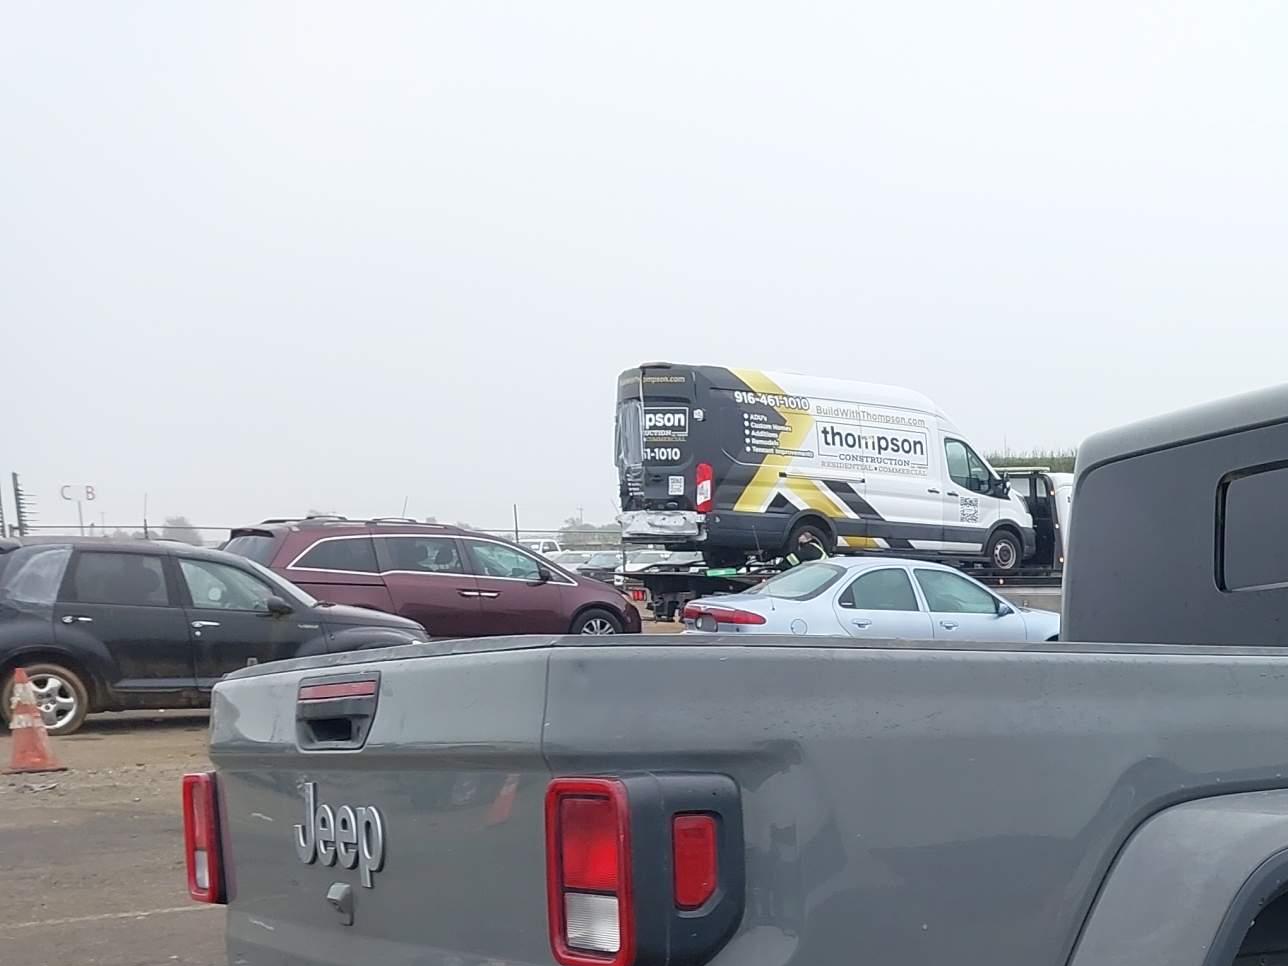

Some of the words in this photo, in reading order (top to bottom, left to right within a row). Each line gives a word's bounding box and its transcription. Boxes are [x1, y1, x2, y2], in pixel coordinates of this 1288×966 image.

[734, 390, 810, 410] 916-461-1010
[816, 405, 926, 426] BuildWithThompson.com
[821, 425, 925, 456] thompson
[820, 460, 873, 472] RESIDENTIAL
[878, 465, 928, 477] COMMERCIAL
[838, 453, 911, 467] CONSTRUCTION
[293, 782, 385, 889] Jeep
